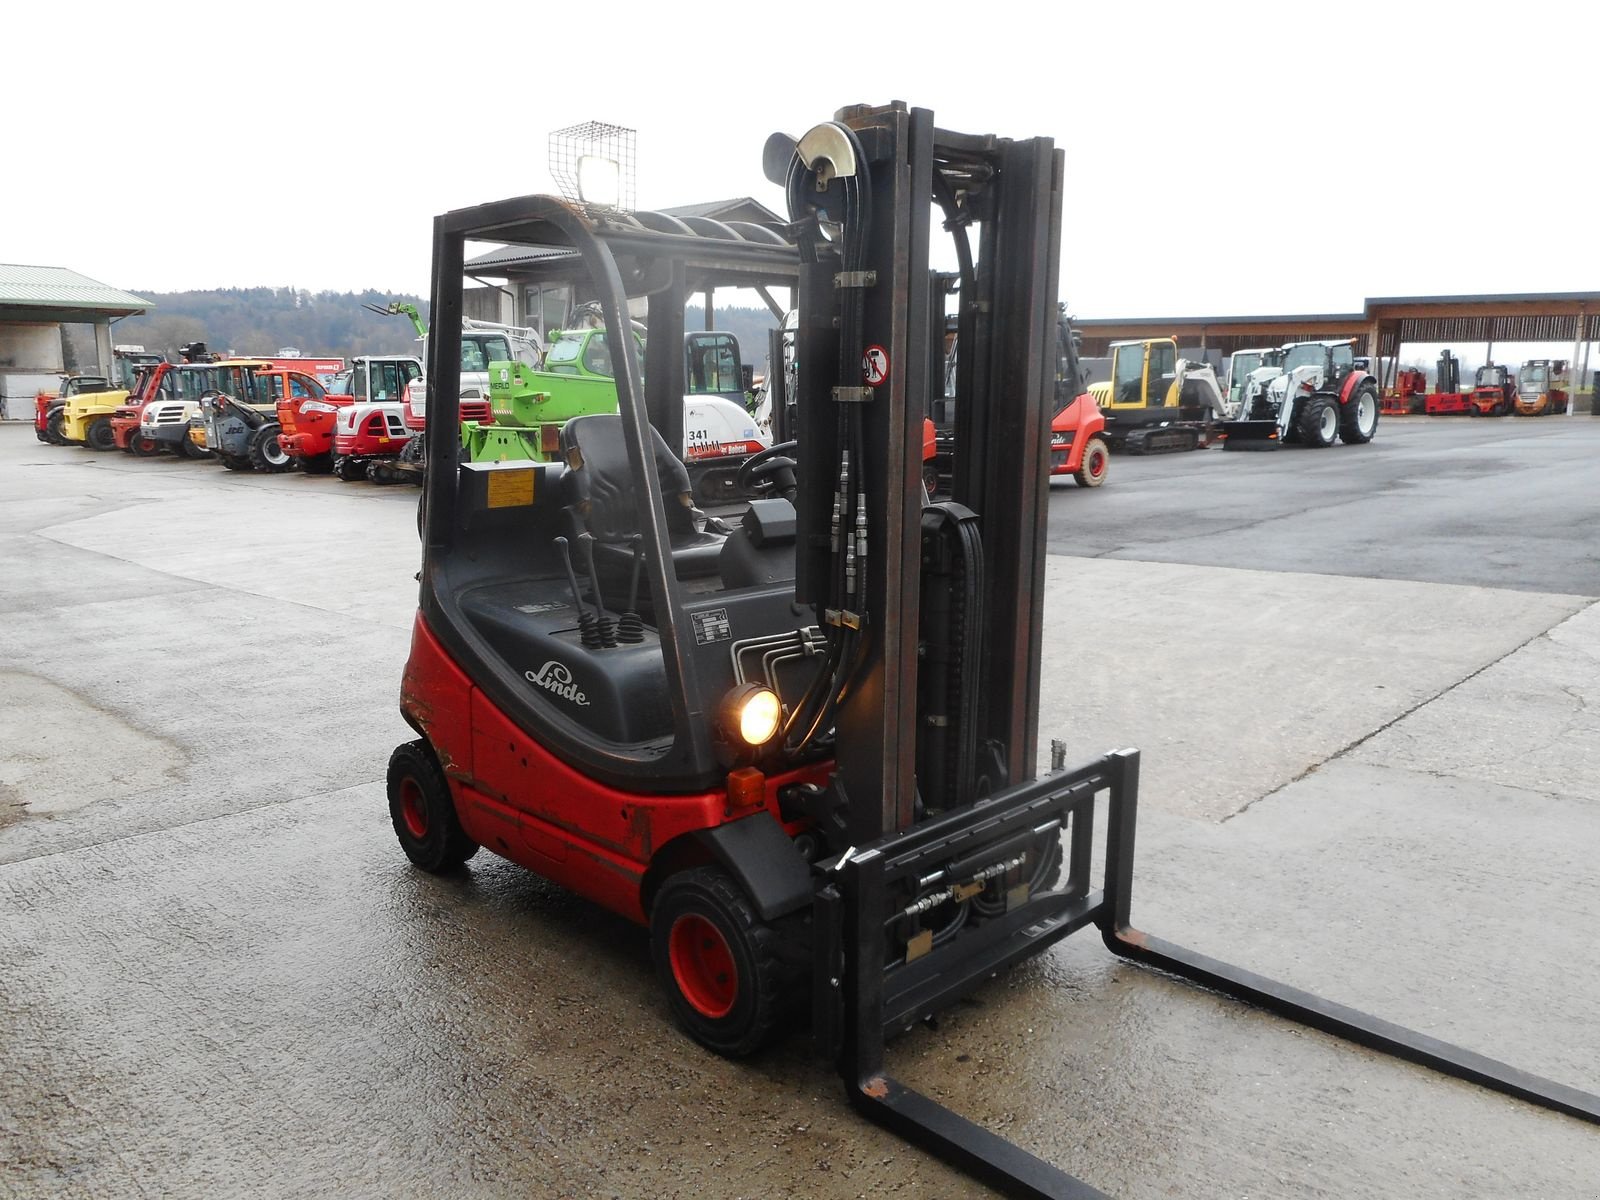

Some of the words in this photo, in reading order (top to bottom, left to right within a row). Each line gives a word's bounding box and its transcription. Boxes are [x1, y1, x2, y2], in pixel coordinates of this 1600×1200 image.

[688, 429, 708, 441] 341
[728, 444, 747, 455] Bobcat
[524, 660, 591, 706] Linde
